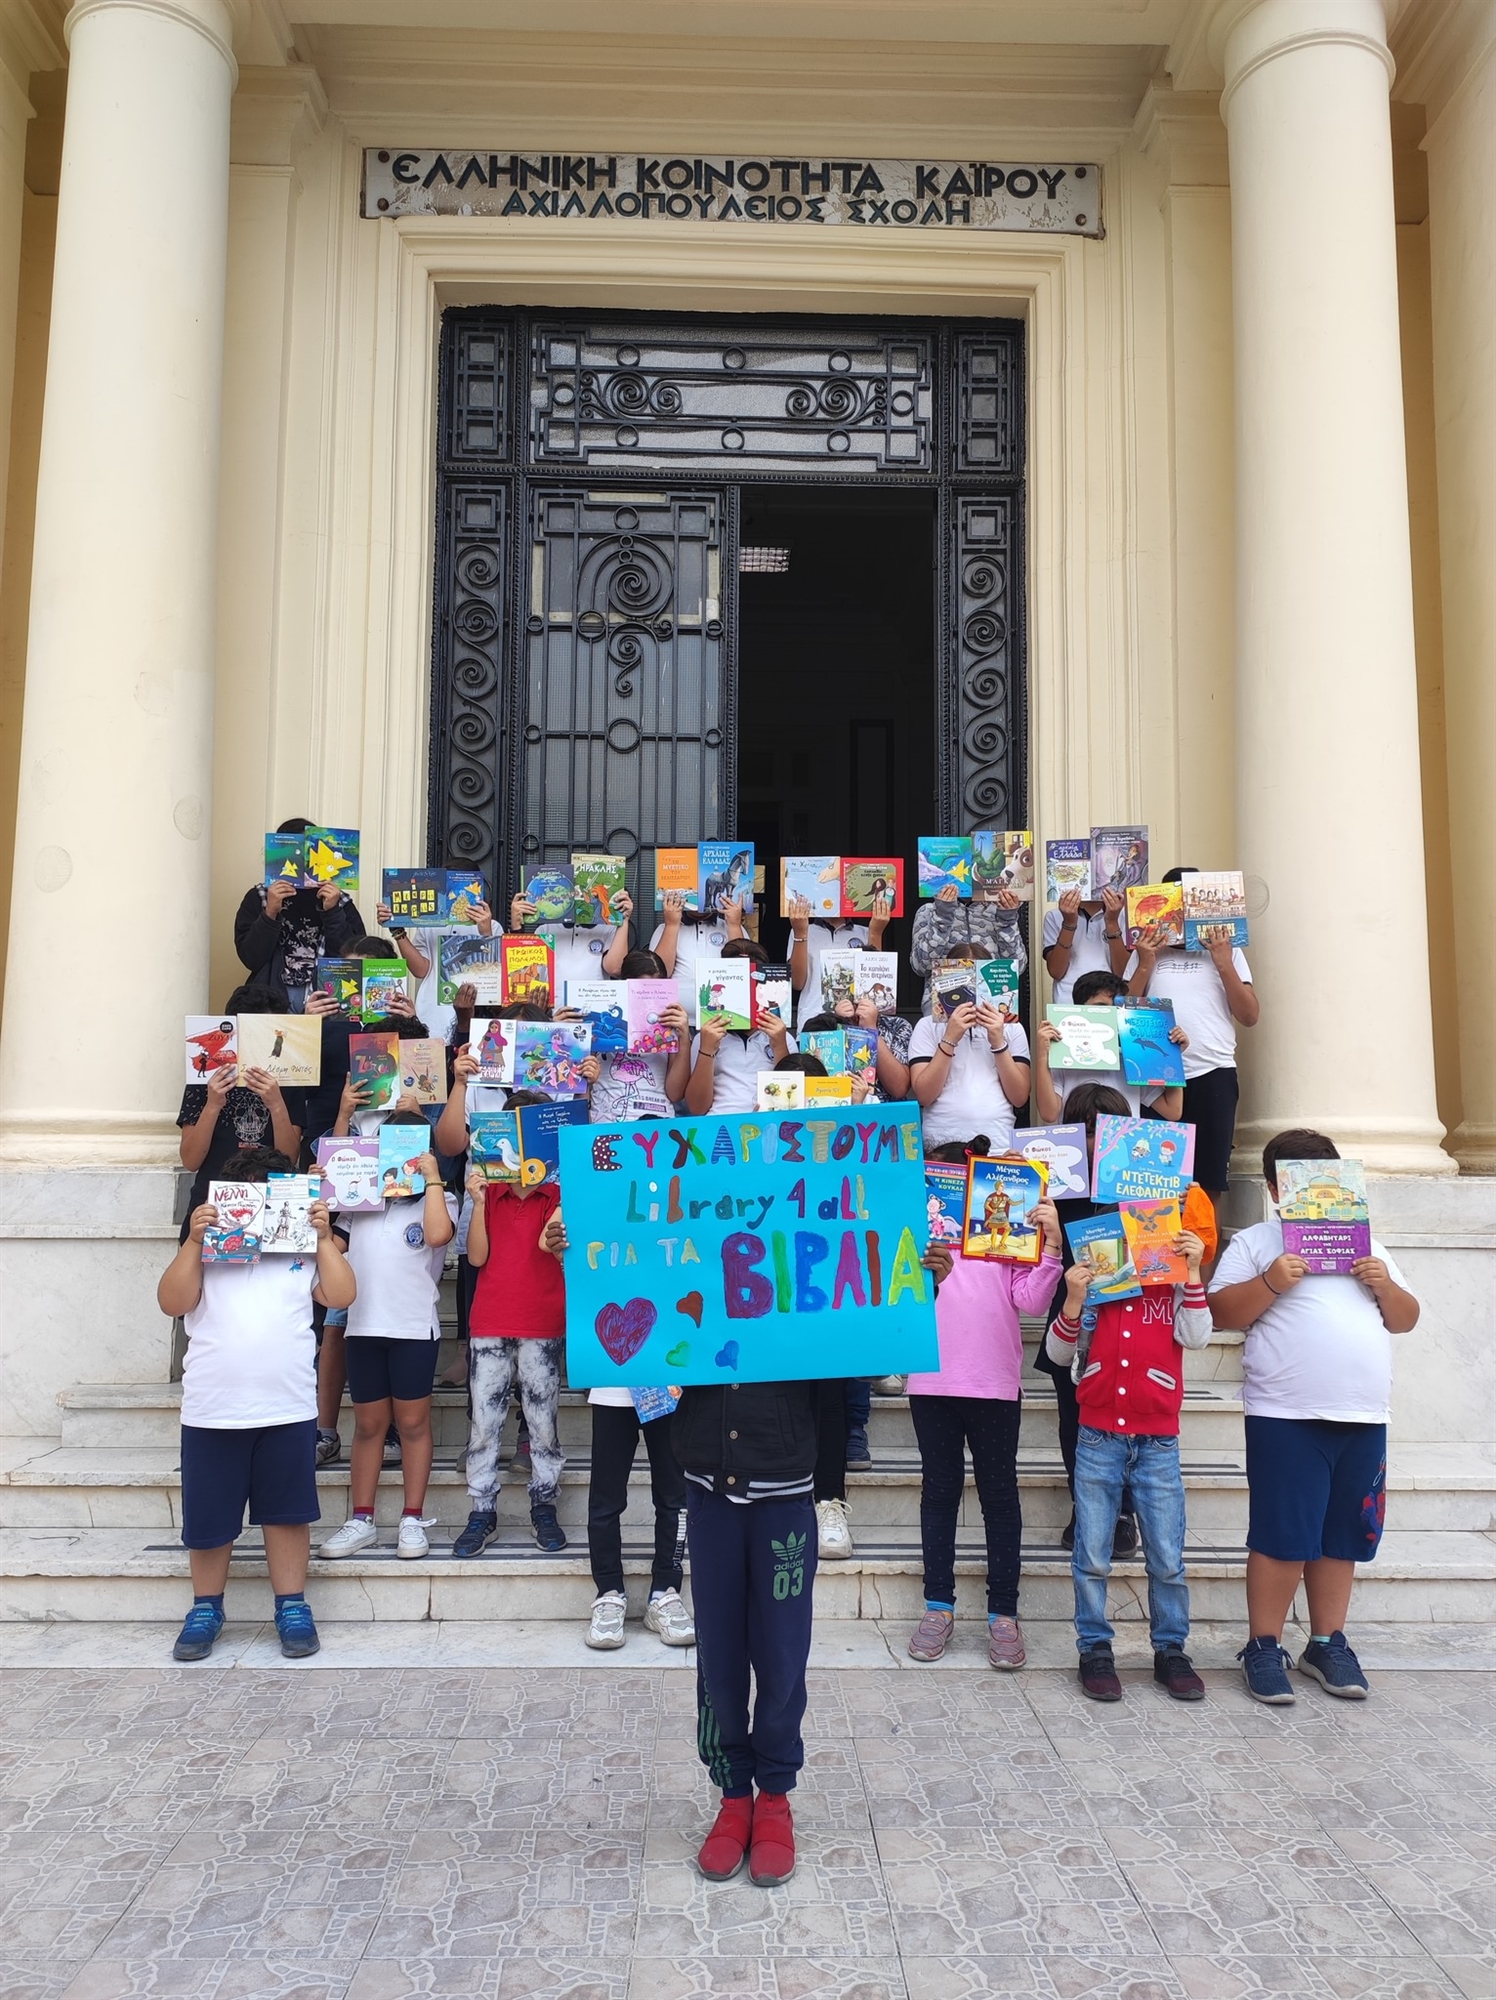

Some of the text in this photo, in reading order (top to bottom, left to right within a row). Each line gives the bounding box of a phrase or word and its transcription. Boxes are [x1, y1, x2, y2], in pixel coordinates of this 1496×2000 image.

[392, 153, 1067, 200] ΕΛΛΗΝΙΚΗ ΚΟΙΝΟΤΗΤΑ ΚΑΪΡΟΥ
[501, 189, 970, 225] ΑΧΙΛΛΟΠΟΥΛΕΙΟΣ ΣΧΟΛΗ
[579, 863, 617, 874] ΗΡΑΚΛΗΣ
[860, 963, 867, 972] Το
[592, 1120, 920, 1172] ΕΥΧΑΡΙΣΤΟΥΜΕ
[985, 1173, 1029, 1185] Αλέξανδρος
[995, 1165, 1021, 1176] Μέγας
[1122, 1170, 1181, 1188] ΝΤΕΤΕΚΤΙΒ
[626, 1175, 775, 1230] Library
[818, 1174, 869, 1220] all
[586, 1226, 928, 1319] ΓΙΑ ΤΑ ΒΙΒΛΙΑ
[1142, 1297, 1173, 1325] M
[774, 1558, 805, 1572] adidas
[773, 1566, 804, 1602] 03
